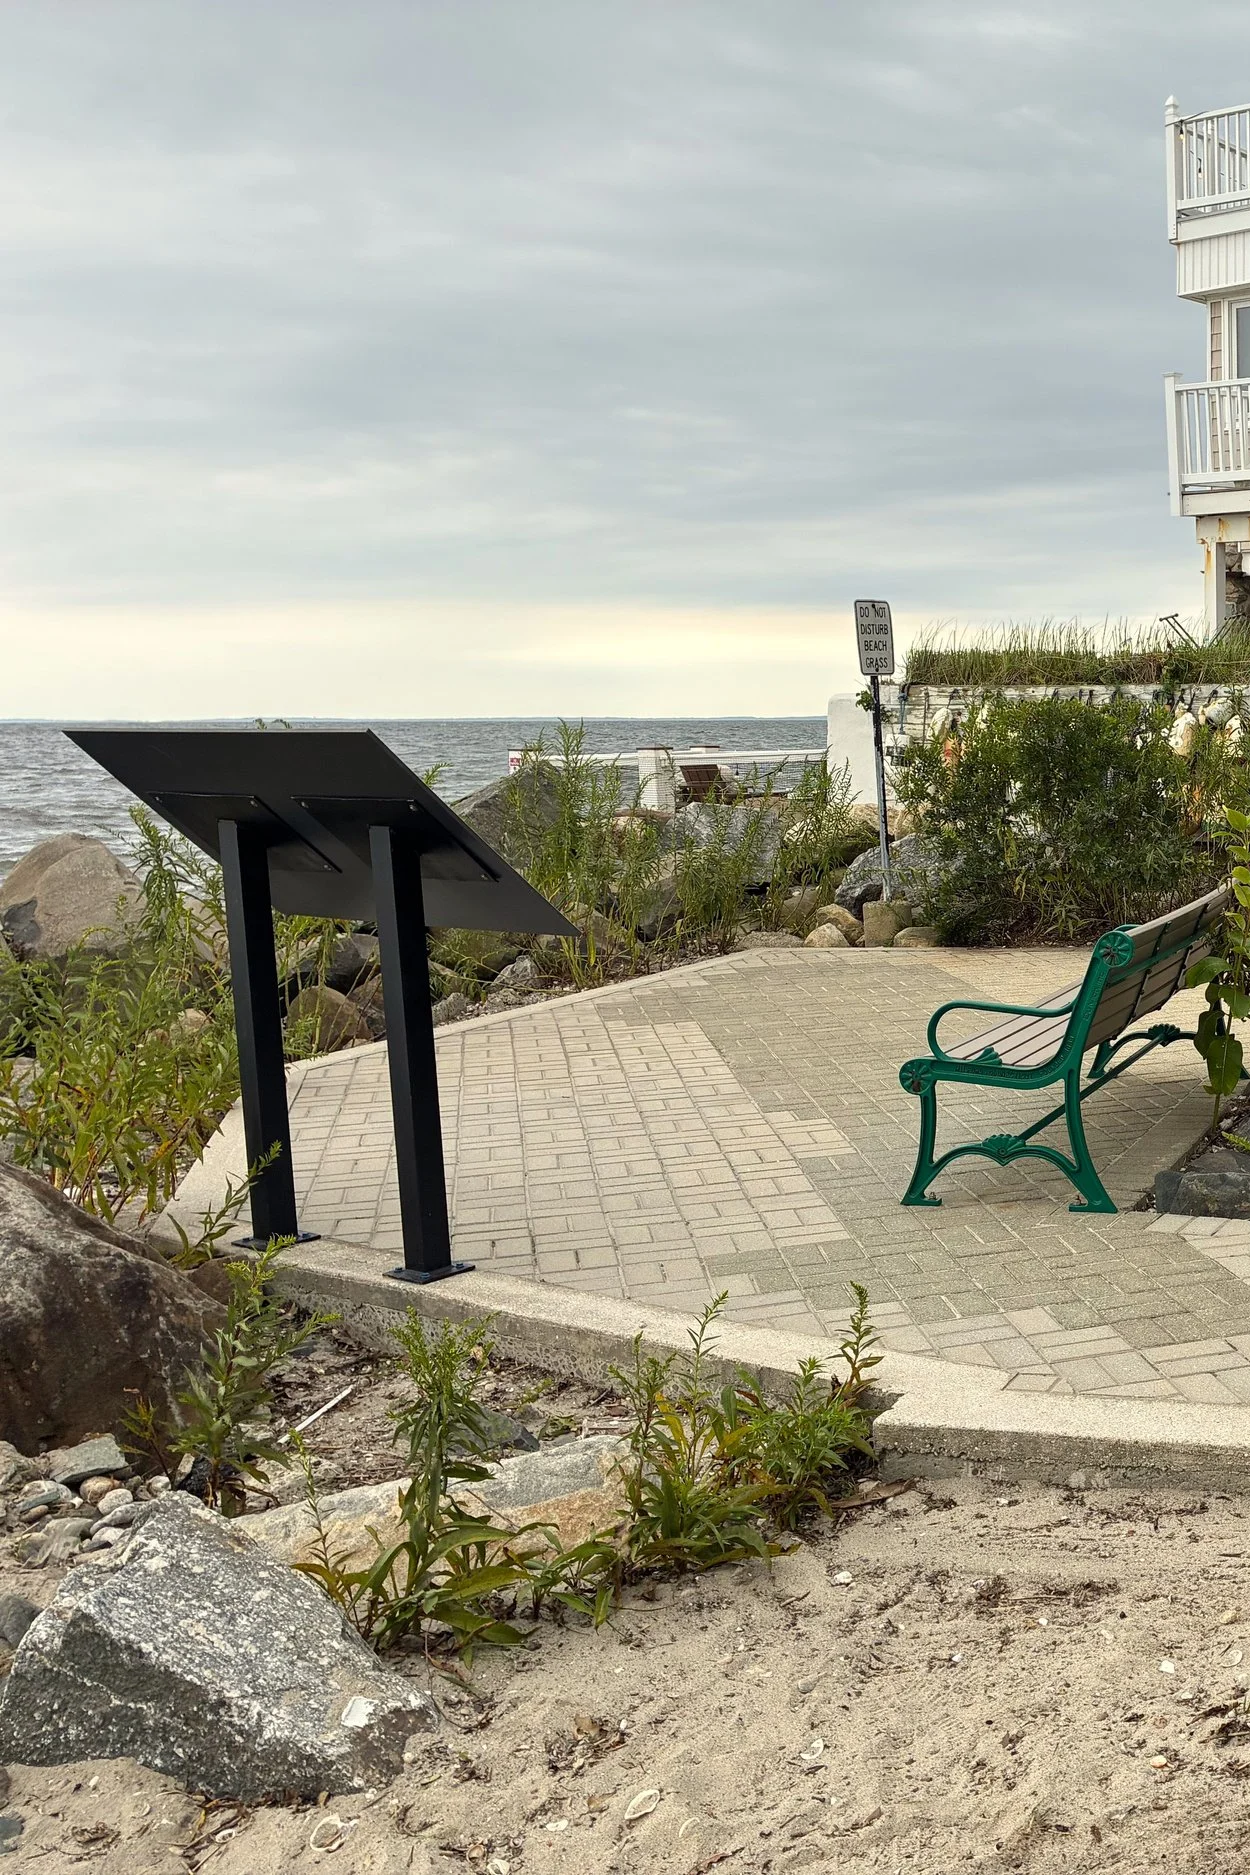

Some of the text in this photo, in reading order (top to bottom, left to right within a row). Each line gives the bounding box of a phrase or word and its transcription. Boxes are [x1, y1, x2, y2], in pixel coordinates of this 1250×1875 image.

[860, 606, 886, 618] DO NOT
[860, 624, 889, 635] DISTURB
[864, 640, 887, 651] BEACH
[865, 657, 888, 668] GRASS
